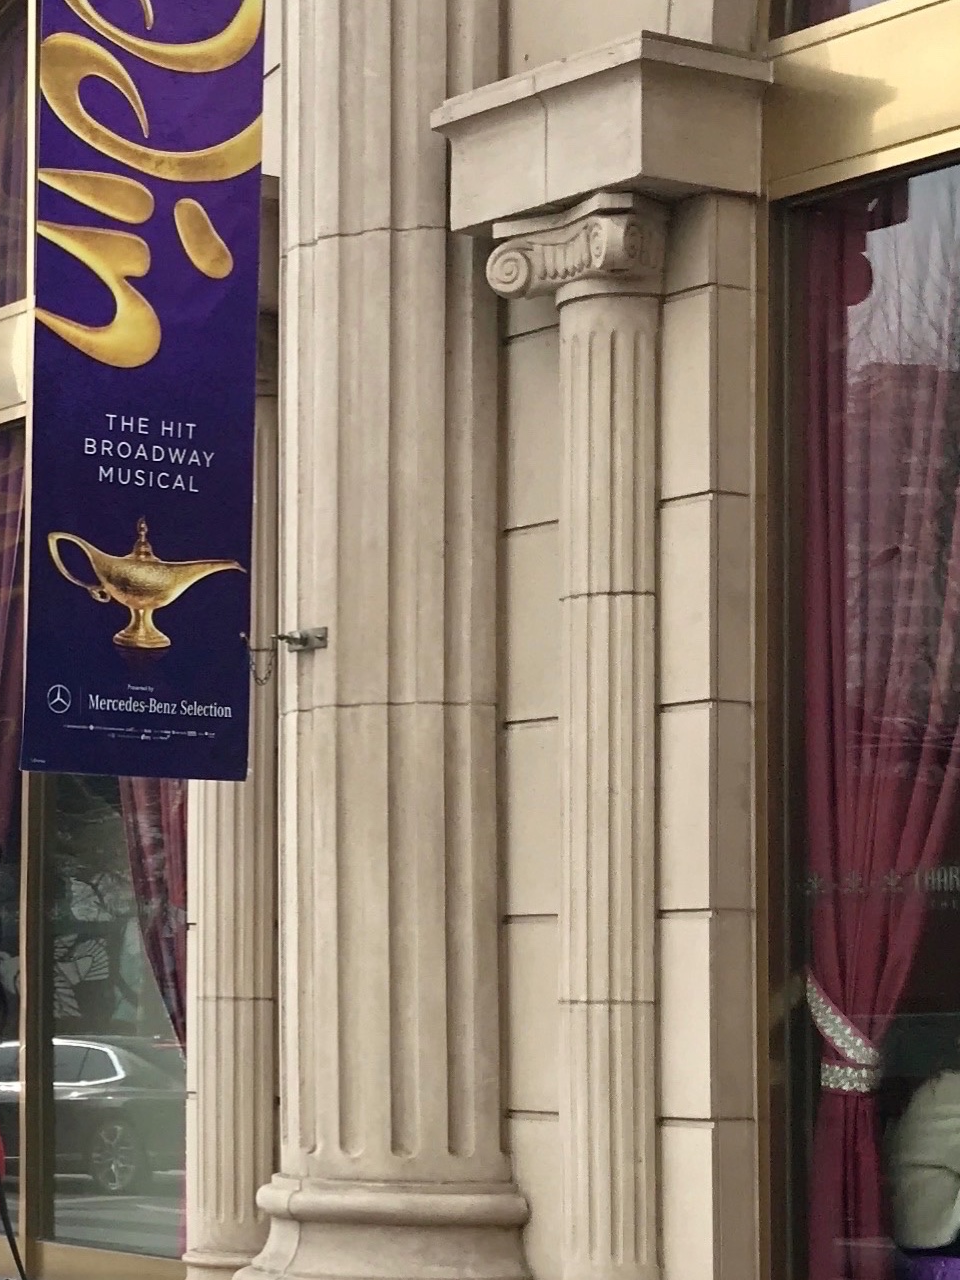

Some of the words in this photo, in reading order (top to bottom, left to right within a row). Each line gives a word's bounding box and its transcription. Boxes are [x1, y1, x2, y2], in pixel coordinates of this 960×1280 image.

[105, 413, 149, 435] THE
[161, 420, 197, 440] HIT
[83, 437, 215, 468] BROADWAY
[98, 465, 199, 493] MUSICAL
[88, 693, 177, 715] Mercedes-Benz
[179, 699, 232, 718] Selection
